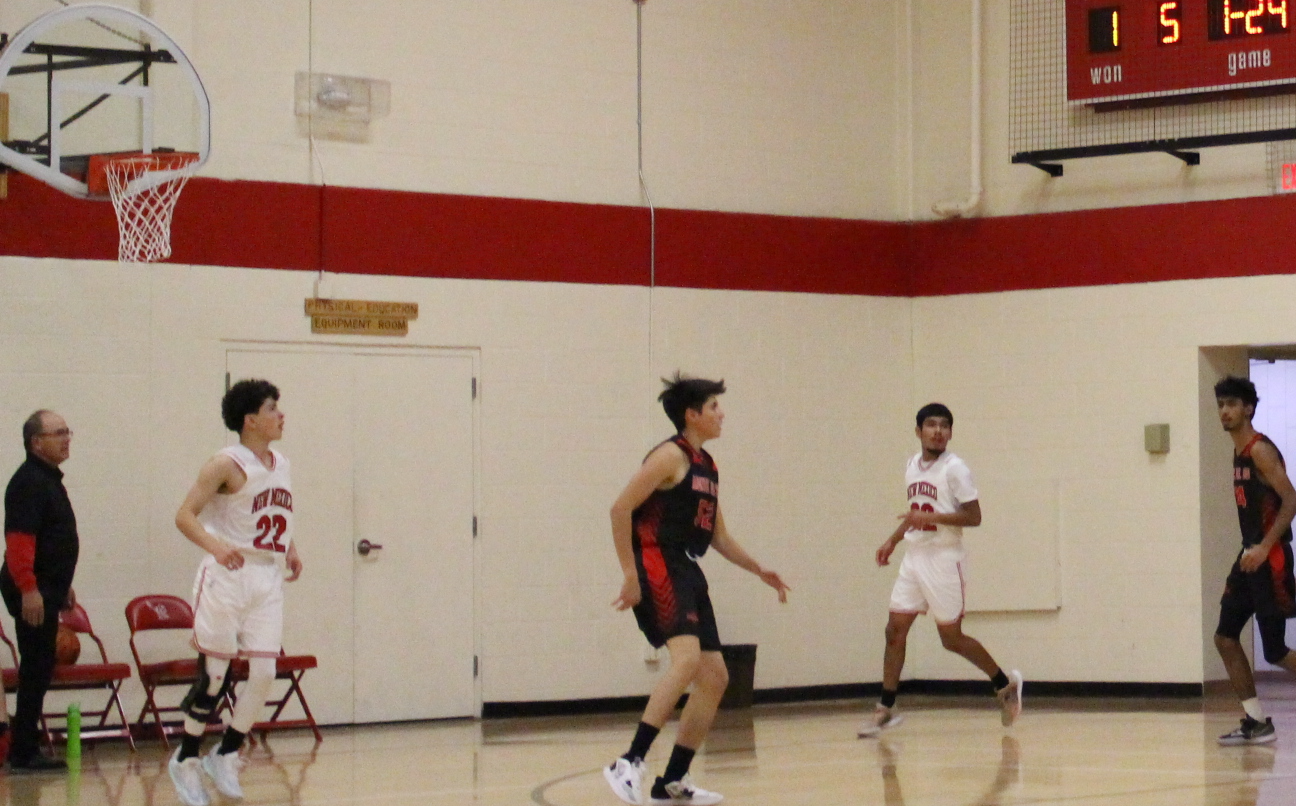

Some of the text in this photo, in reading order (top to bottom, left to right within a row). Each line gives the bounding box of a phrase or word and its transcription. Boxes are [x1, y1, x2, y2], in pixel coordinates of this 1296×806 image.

[1112, 11, 1118, 47] 1
[1159, 2, 1180, 44] 5
[1091, 64, 1122, 85] won
[1228, 49, 1271, 76] game
[314, 318, 406, 330] EQUIPMENT ROOM
[253, 515, 287, 553] 22
